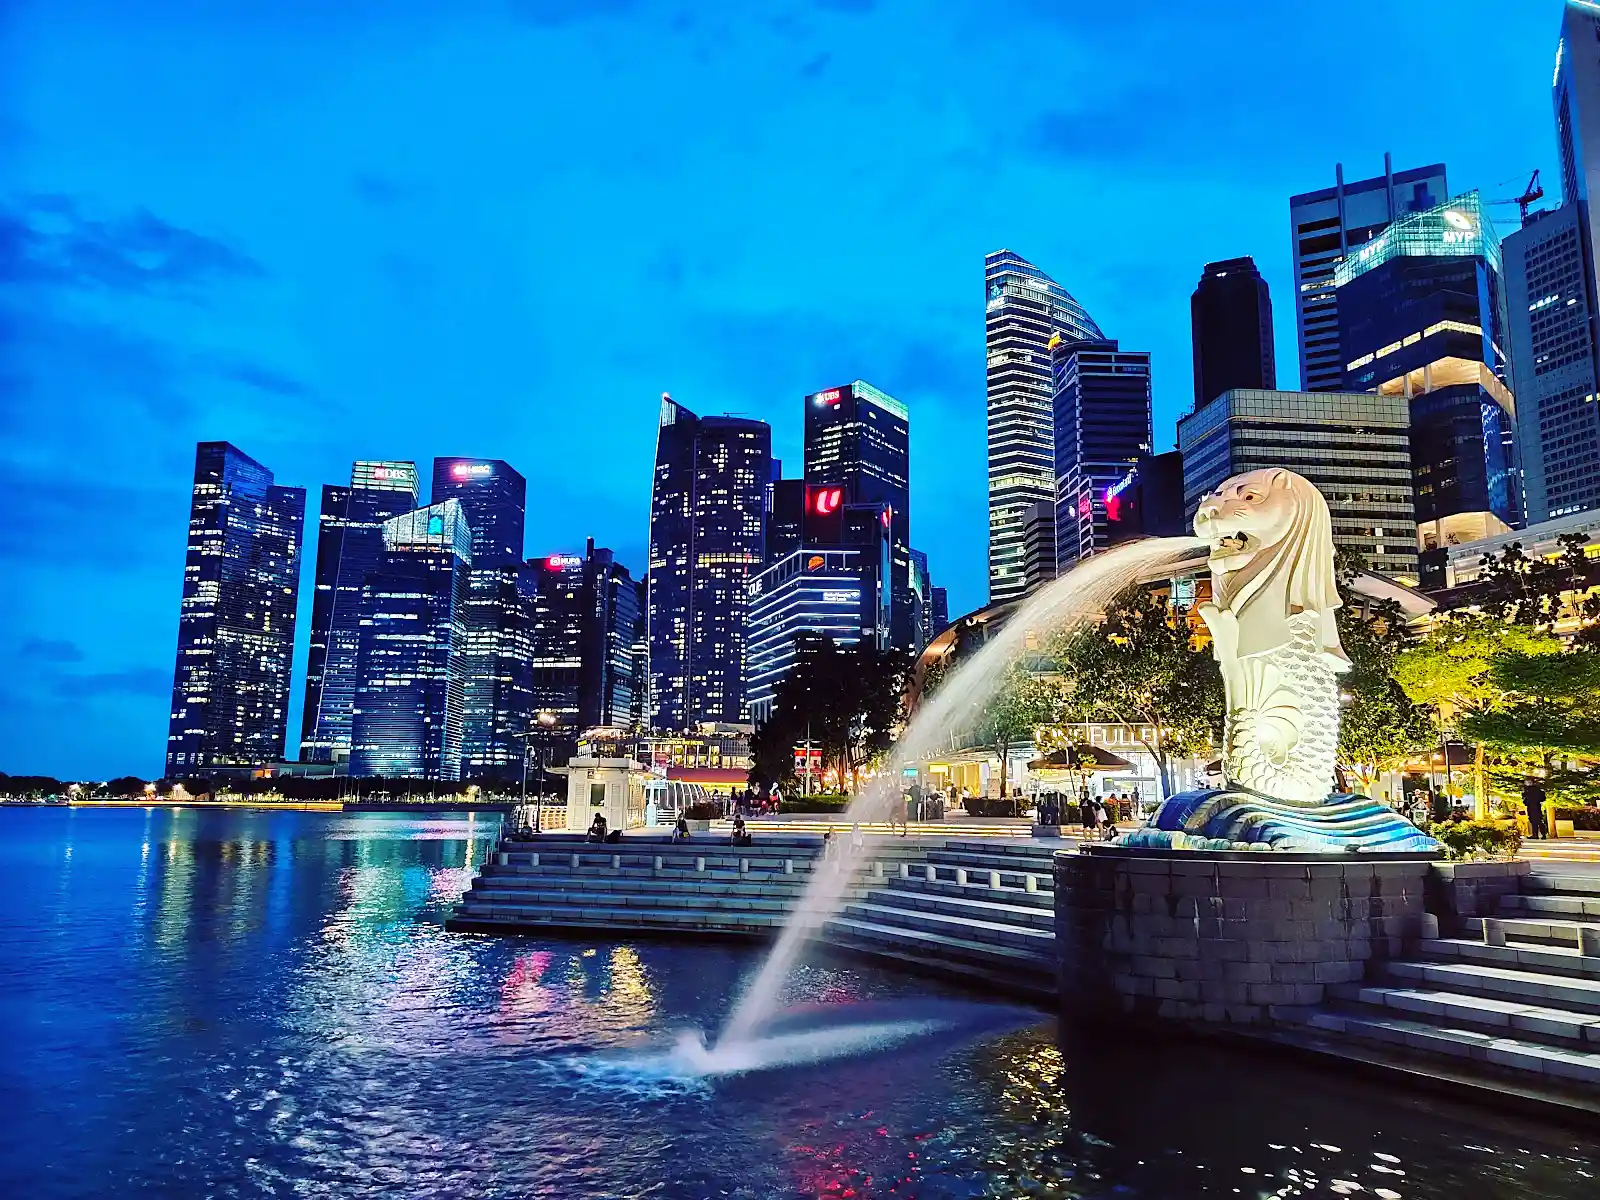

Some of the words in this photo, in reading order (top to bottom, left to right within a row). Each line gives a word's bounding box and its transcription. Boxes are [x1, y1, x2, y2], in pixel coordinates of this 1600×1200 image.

[1443, 231, 1475, 243] MYP
[824, 390, 840, 401] UBS
[385, 468, 408, 479] DBS
[748, 578, 763, 597] OUE
